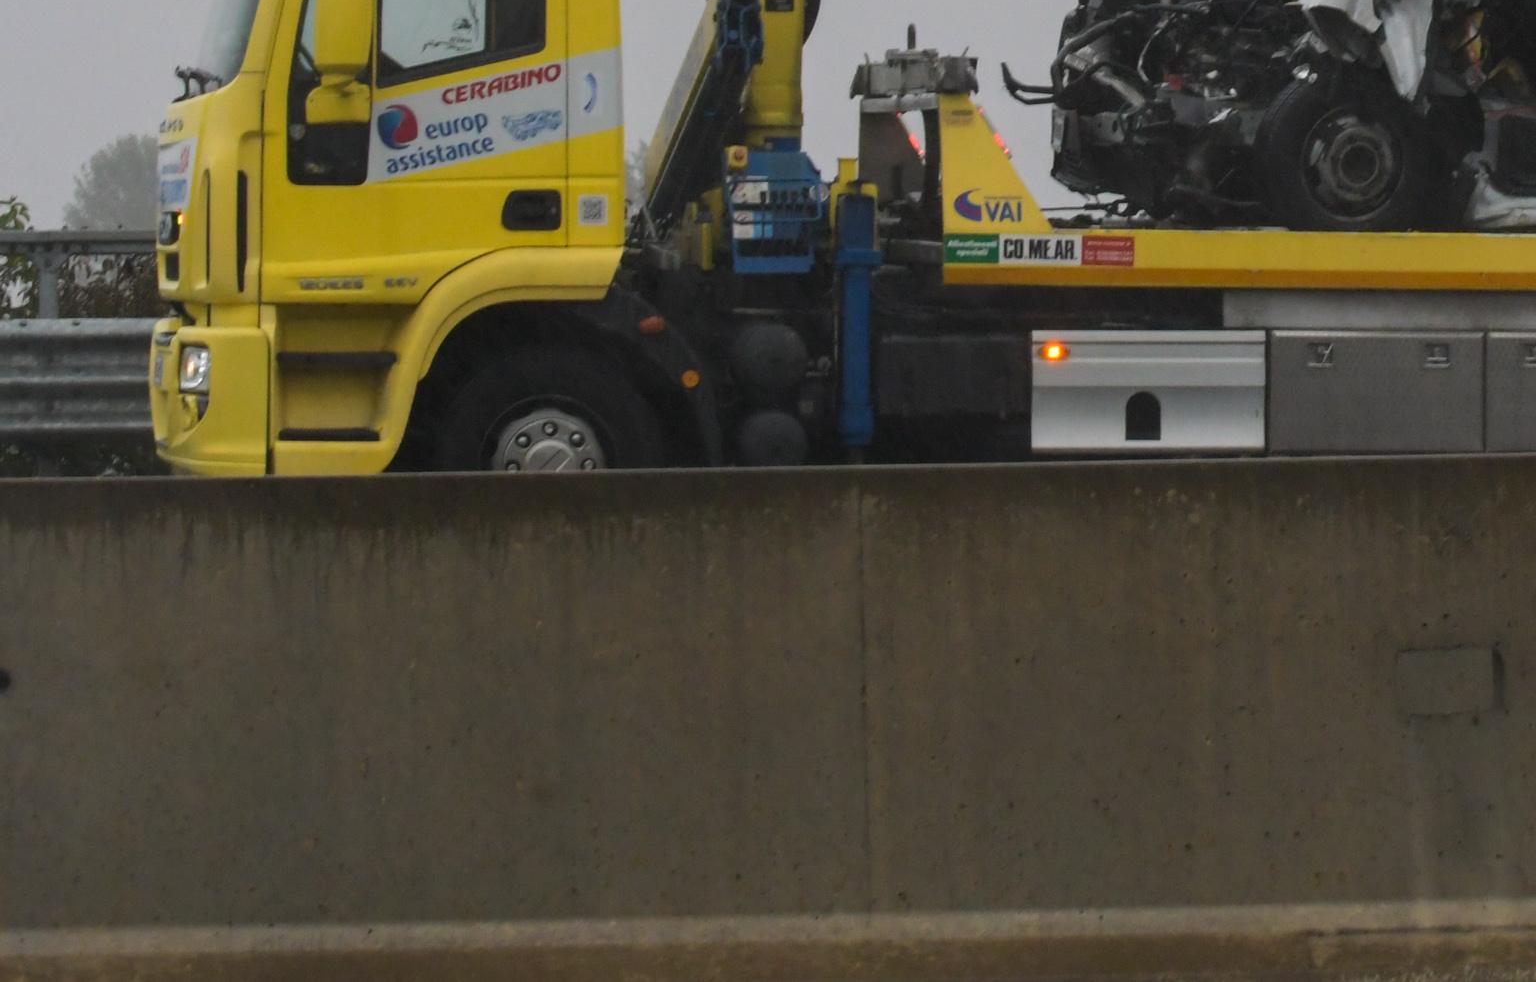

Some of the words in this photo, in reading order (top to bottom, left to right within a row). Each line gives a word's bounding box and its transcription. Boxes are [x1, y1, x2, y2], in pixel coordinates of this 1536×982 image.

[442, 64, 561, 104] CERABINO
[426, 113, 488, 139] europ
[387, 137, 494, 174] assistance
[984, 201, 1023, 222] VAI
